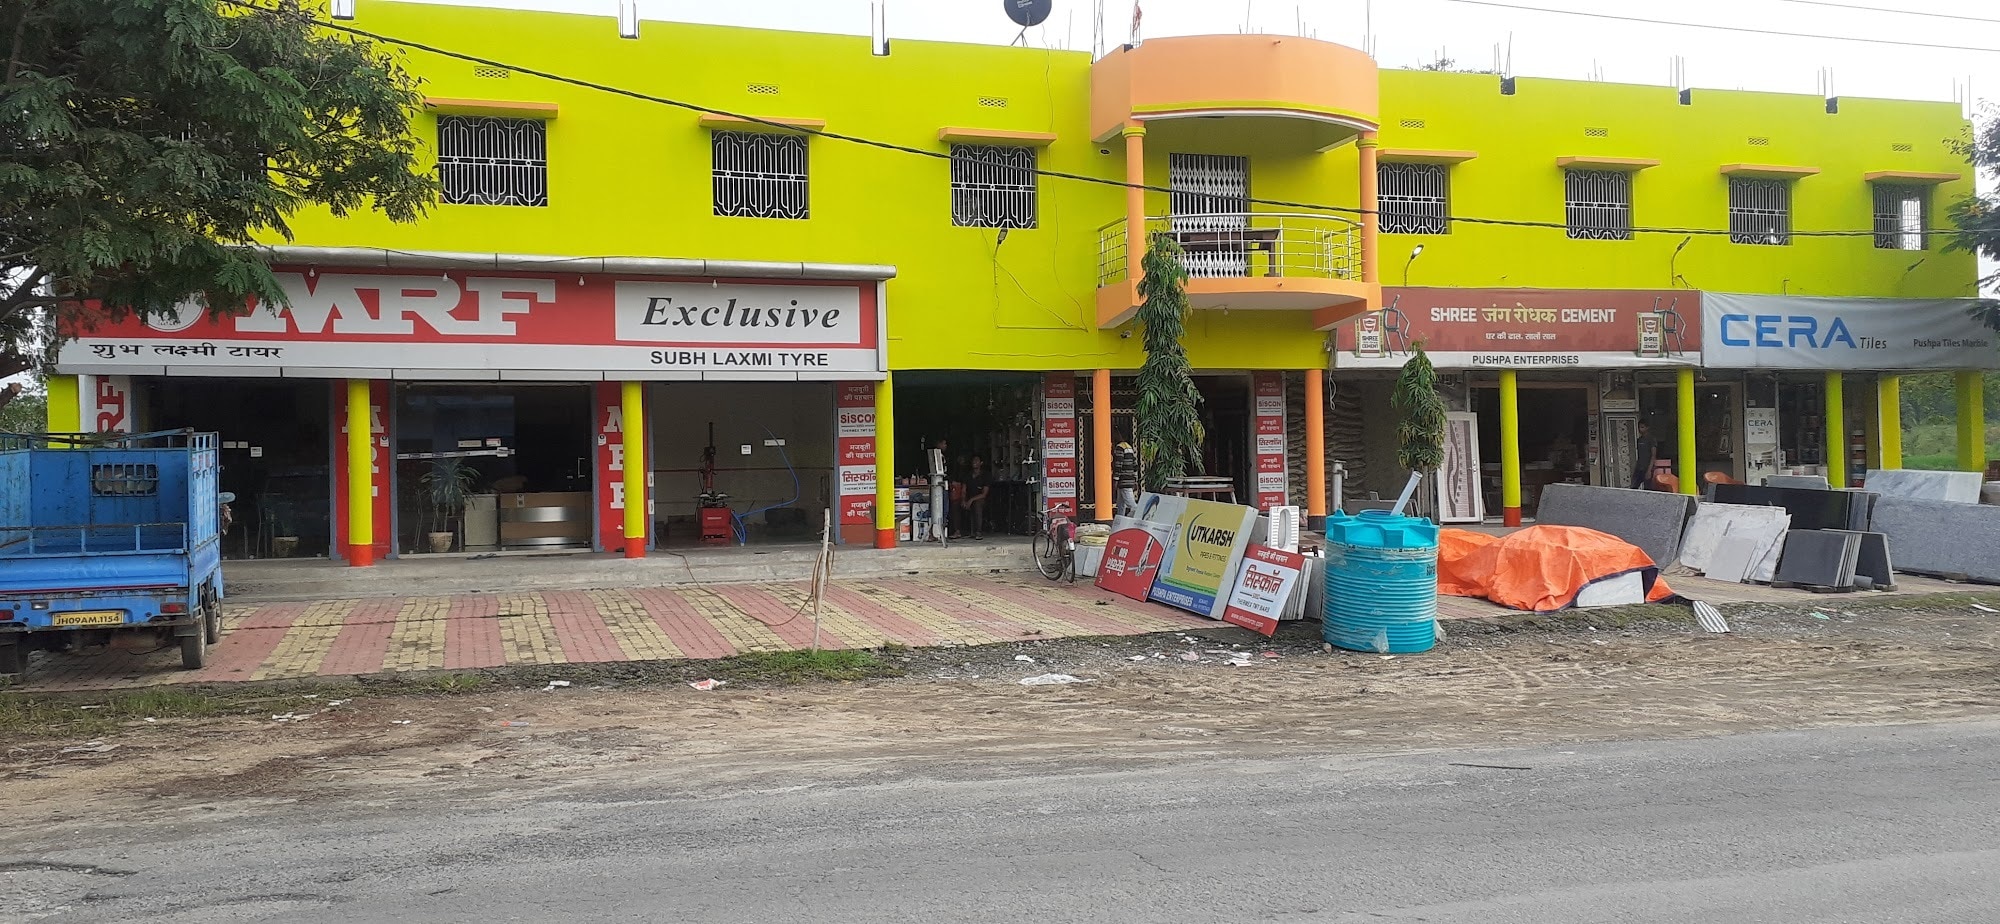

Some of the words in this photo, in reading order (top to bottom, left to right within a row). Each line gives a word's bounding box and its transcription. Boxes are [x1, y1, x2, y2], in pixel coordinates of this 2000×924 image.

[235, 272, 556, 336] MRF
[641, 296, 840, 328] Exclusive
[1430, 307, 1477, 322] SHREE
[1481, 304, 1511, 323] जंग
[1513, 302, 1557, 324] रोधक
[1561, 308, 1616, 323] CEMENT
[1497, 331, 1506, 340] की
[1721, 313, 1857, 349] CERA
[1860, 337, 1887, 349] Tiles
[1913, 338, 1941, 349] Pushpa
[1943, 339, 1961, 347] Tiles
[89, 344, 144, 359] शुभ
[151, 342, 218, 357] लक्ष्मी
[226, 346, 284, 358] टायर
[650, 350, 706, 365] SUBH
[713, 351, 772, 366] LAXMI
[778, 353, 829, 366] TYRE
[1472, 355, 1511, 364] PUSHPA
[1513, 355, 1579, 364] ENTERPRISES
[850, 443, 871, 451] मजबूती
[846, 451, 854, 459] की
[847, 509, 855, 517] की
[1190, 524, 1236, 547] UTKARSH
[1242, 564, 1285, 596] सिस्कॉन
[56, 616, 119, 625] JH09AM.1154
